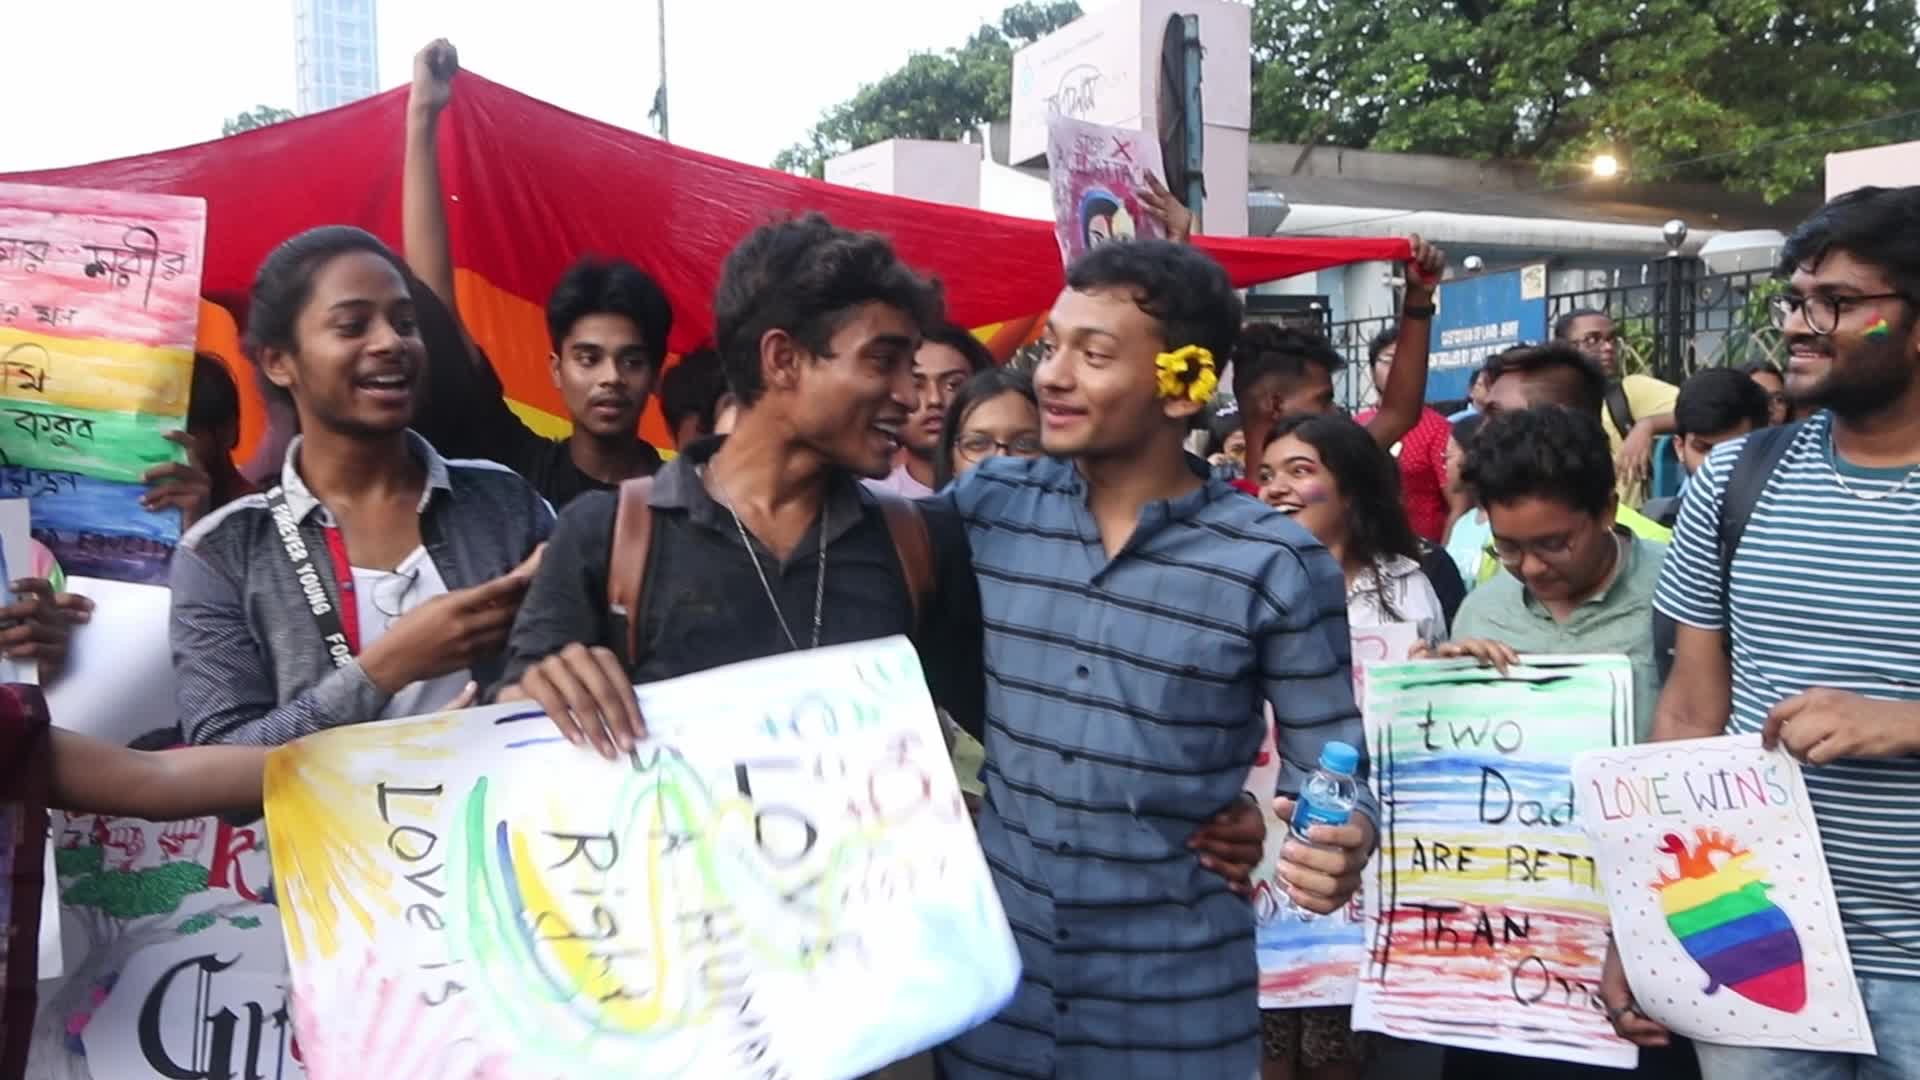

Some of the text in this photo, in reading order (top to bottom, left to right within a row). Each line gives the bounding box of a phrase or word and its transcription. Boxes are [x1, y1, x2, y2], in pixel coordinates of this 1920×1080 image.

[296, 562, 332, 616] YOUNG
[1417, 700, 1523, 754] two
[1480, 765, 1576, 828] Dad
[1592, 766, 1789, 821] LOVE WINS
[376, 780, 447, 931] Love
[1411, 835, 1597, 892] ARE BETT
